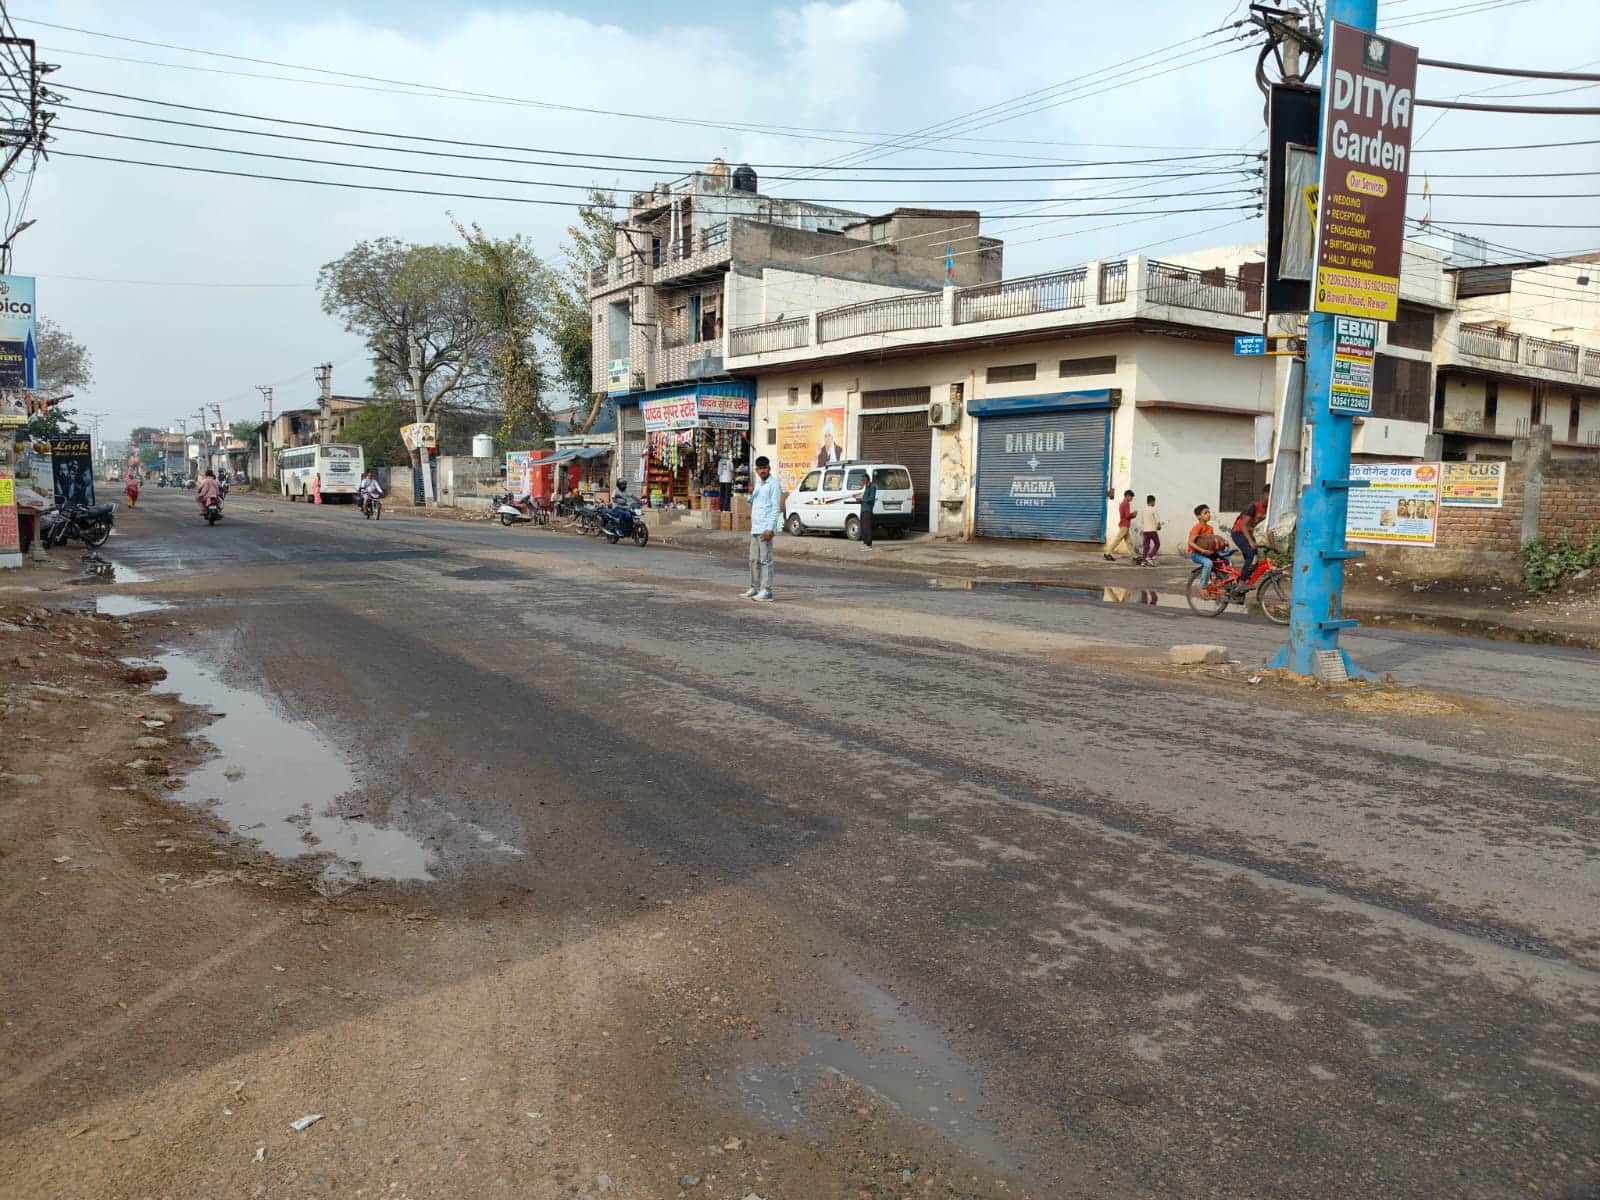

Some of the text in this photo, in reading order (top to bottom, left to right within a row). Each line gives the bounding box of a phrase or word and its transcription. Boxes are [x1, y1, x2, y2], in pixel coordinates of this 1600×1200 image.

[1333, 69, 1412, 129] DITYA
[1332, 119, 1406, 173] Garden
[1331, 209, 1366, 224] RECEPTION
[1330, 225, 1371, 239] ENGAGEMENT
[1329, 239, 1377, 255] BIRTHDAY PARTY
[1338, 319, 1374, 339] EBM
[1340, 336, 1371, 347] ACADEMY
[1390, 468, 1412, 477] यादव
[1009, 481, 1056, 497] MAGNA
[1015, 499, 1045, 507] CEMENT
